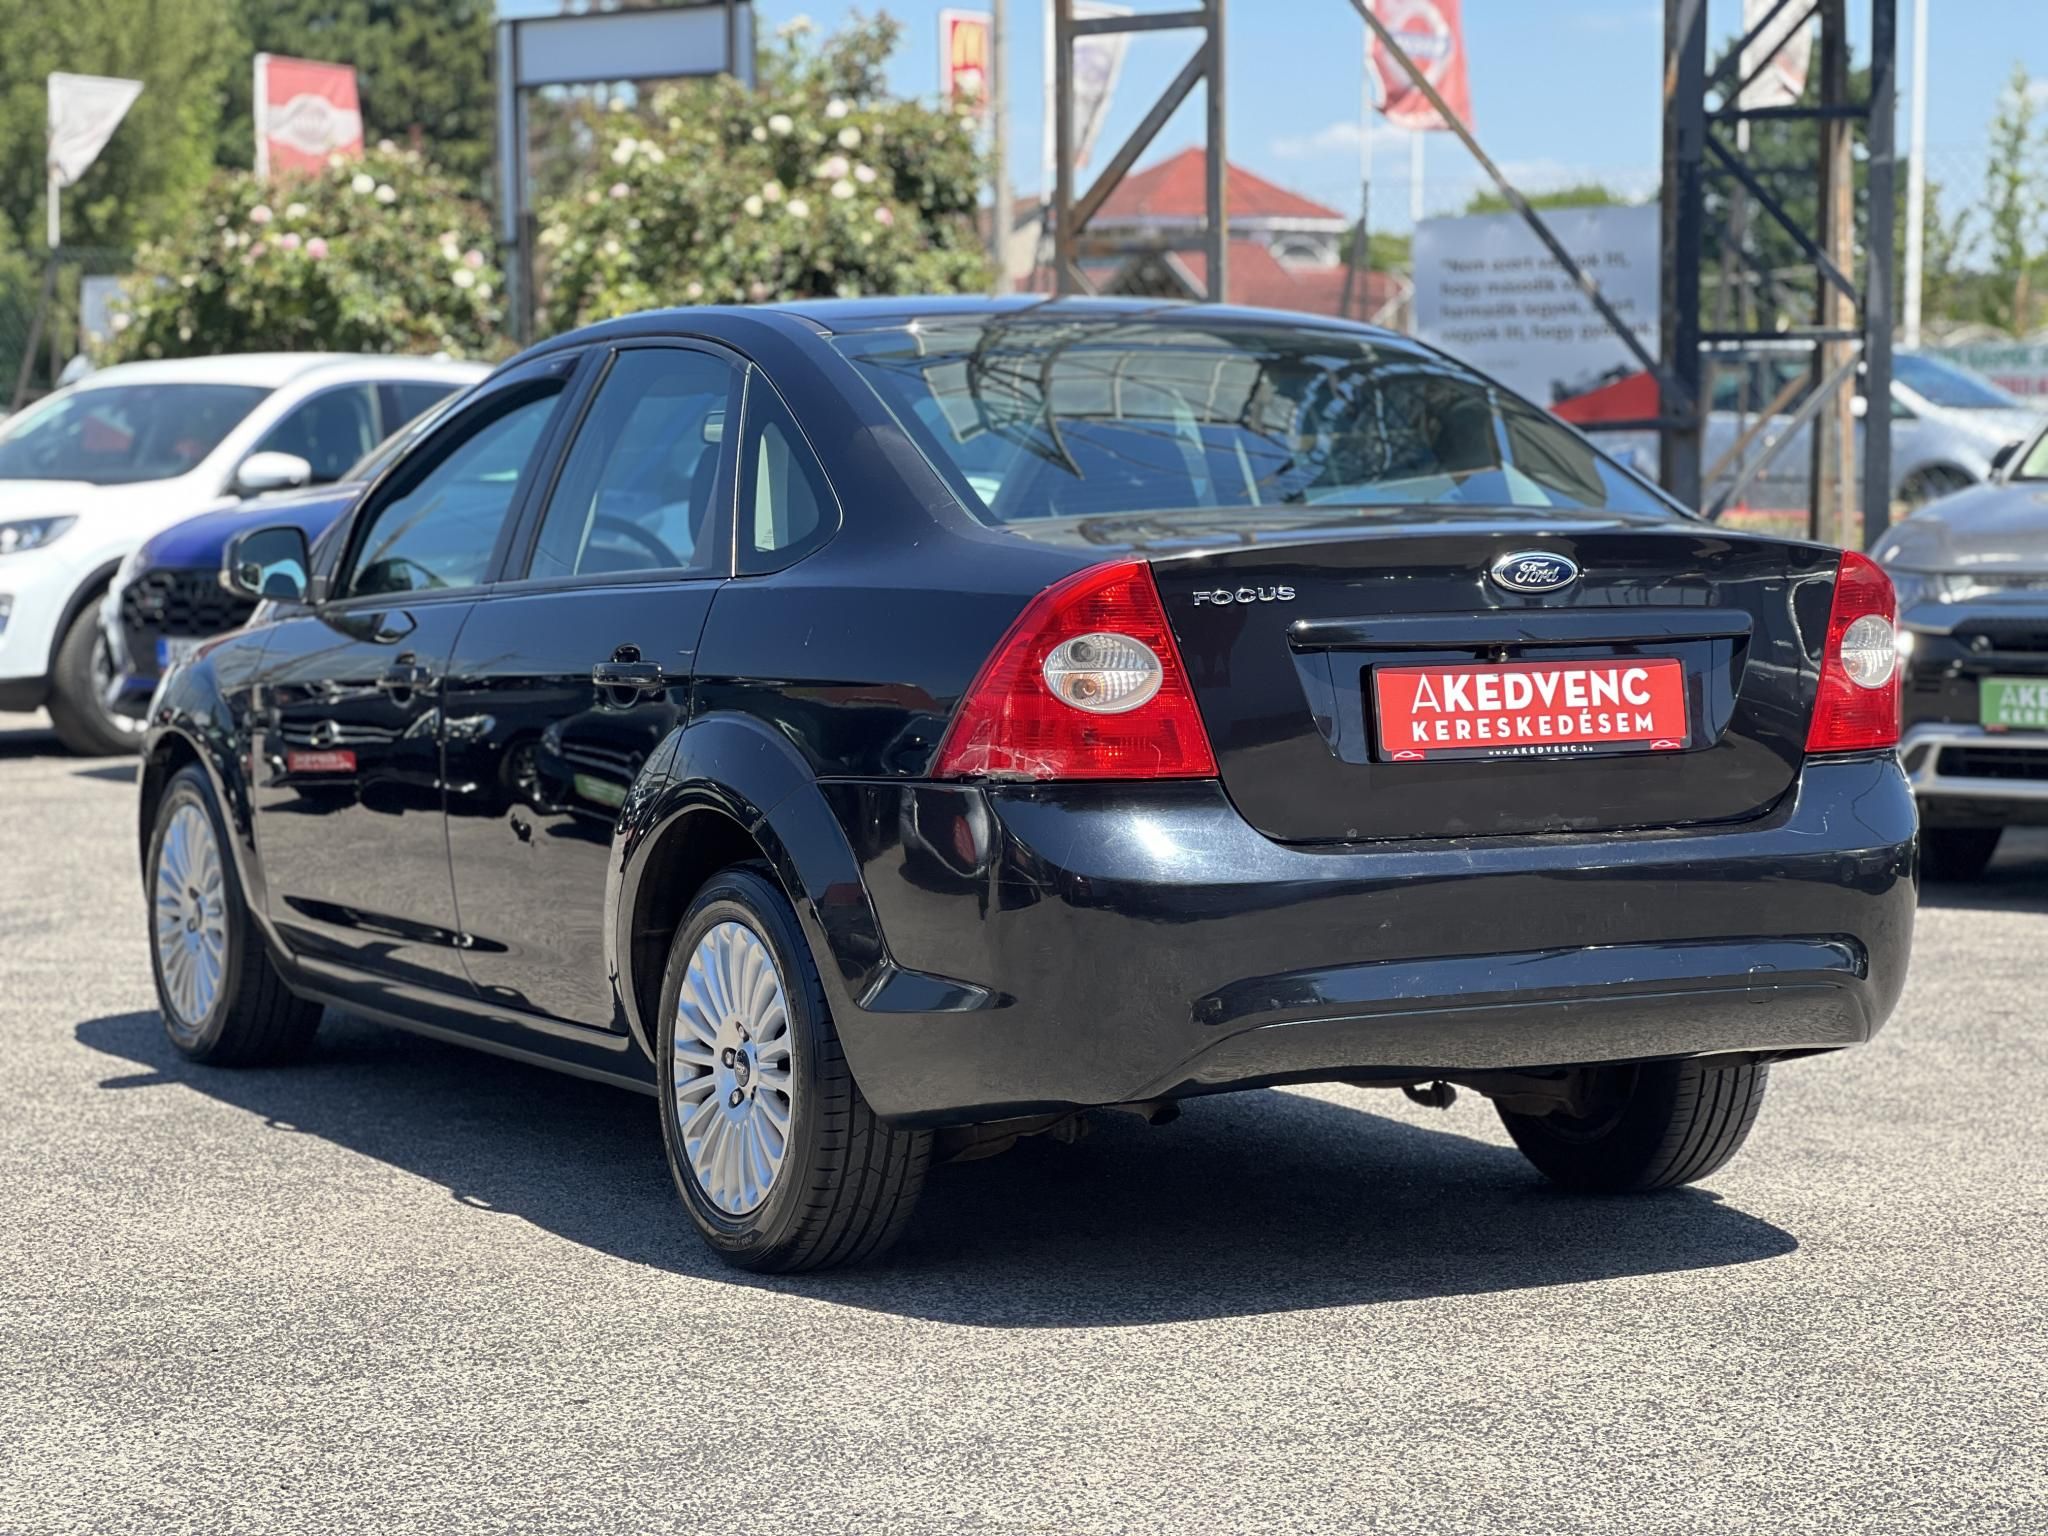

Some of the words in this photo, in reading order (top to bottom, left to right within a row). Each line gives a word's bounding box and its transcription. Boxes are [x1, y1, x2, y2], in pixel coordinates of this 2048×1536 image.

[1515, 561, 1559, 583] Ford
[1193, 586, 1296, 606] FOCUS
[1411, 668, 1651, 713] AKEDVENC
[1412, 708, 1654, 742] KERESKEDÉSEM
